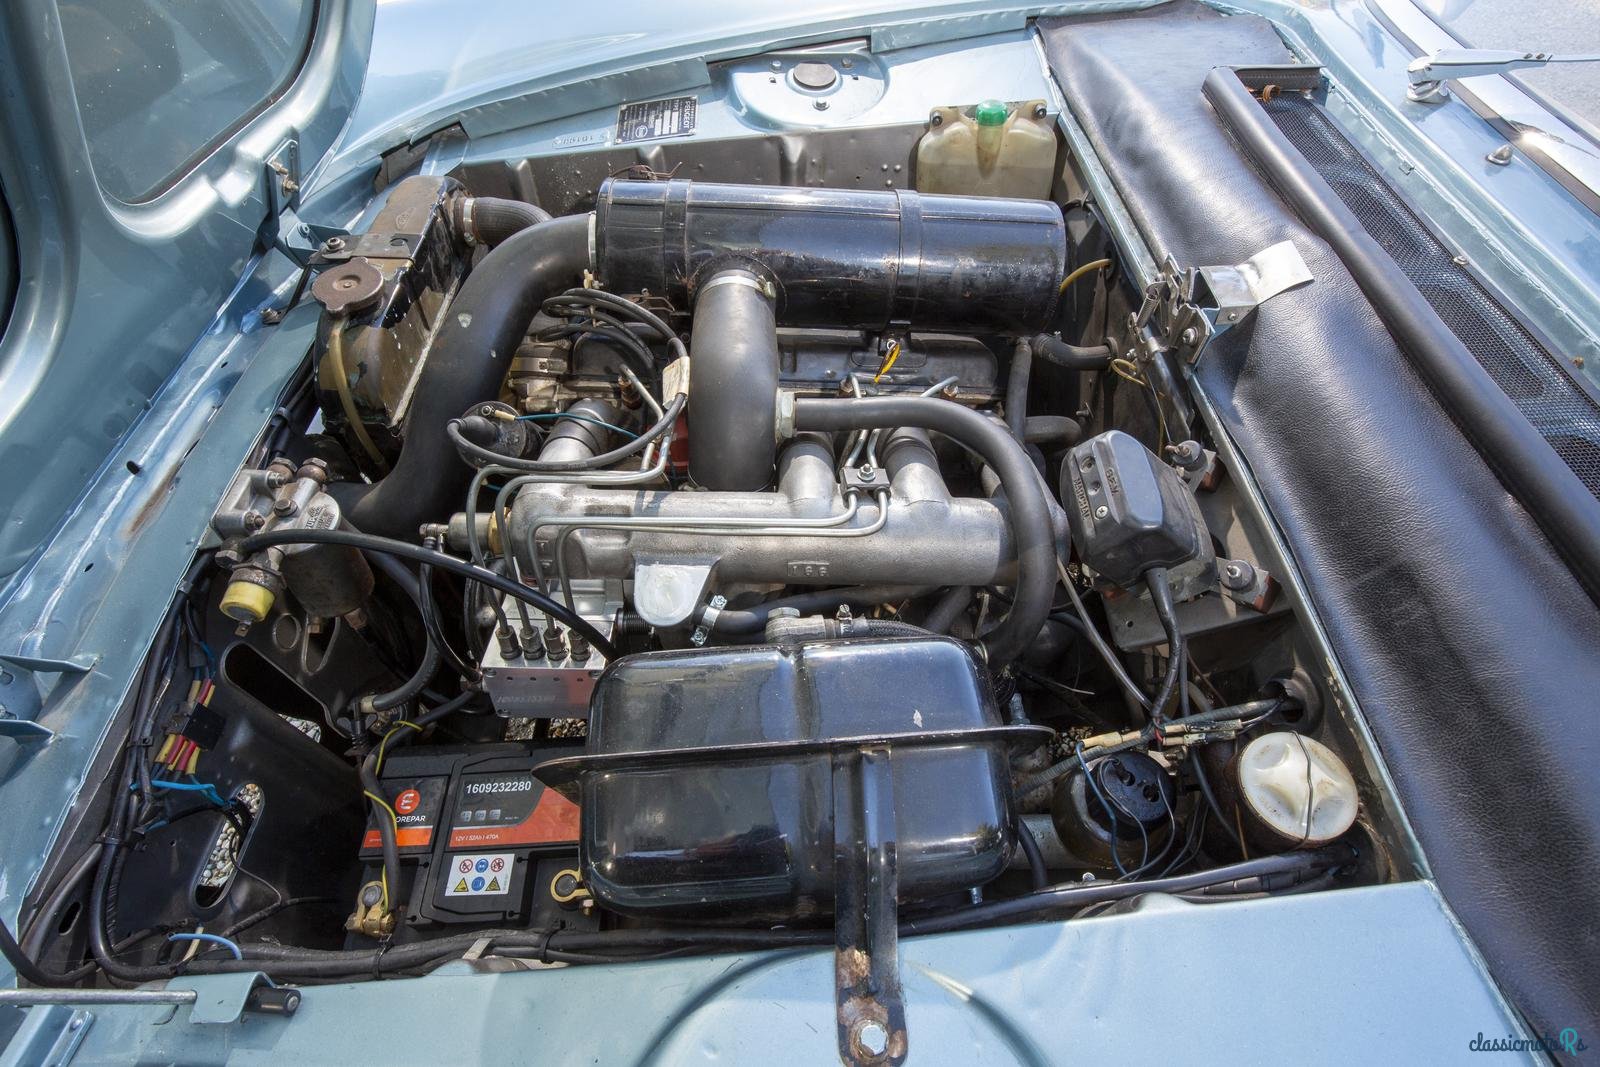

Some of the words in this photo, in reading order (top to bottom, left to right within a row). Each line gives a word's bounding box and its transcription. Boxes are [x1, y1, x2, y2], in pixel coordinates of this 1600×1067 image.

[683, 101, 691, 129] PEUGEOT
[1073, 478, 1089, 519] MARCHAL
[466, 781, 532, 794] 1609232280
[396, 815, 426, 823] OREPAR
